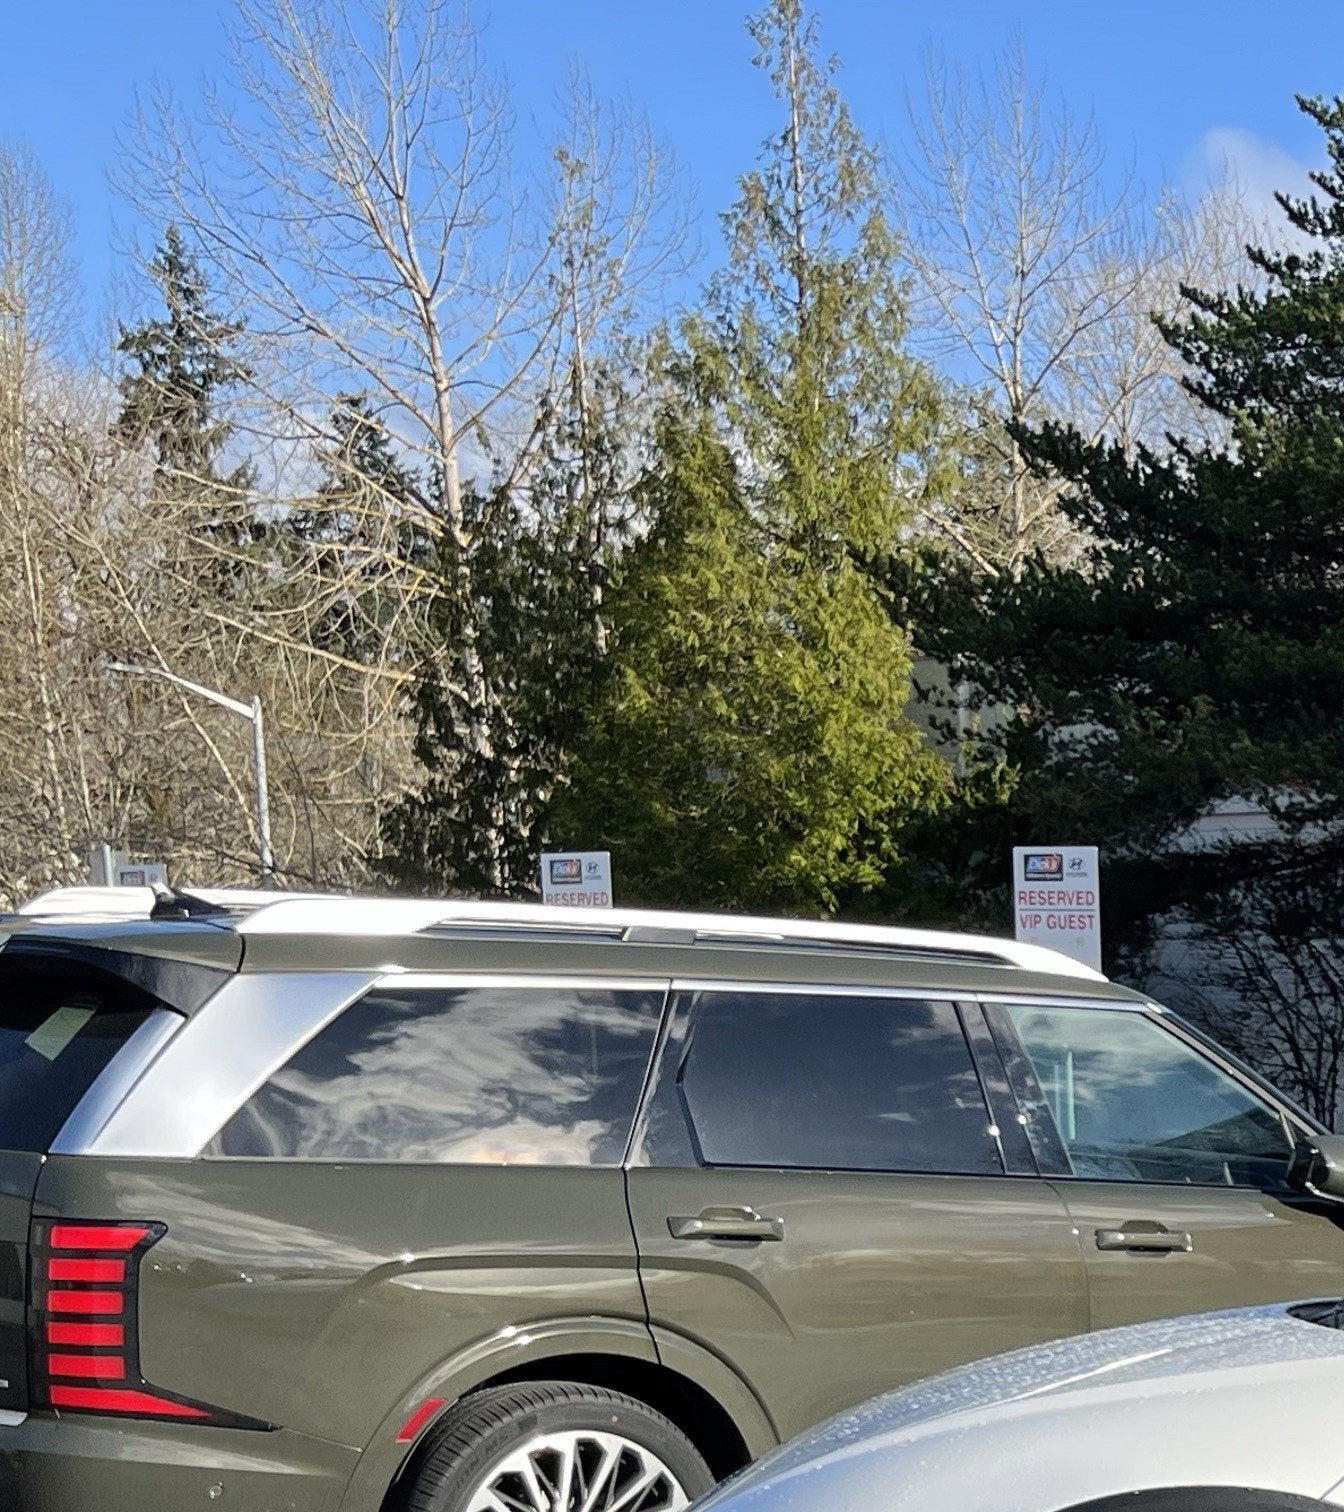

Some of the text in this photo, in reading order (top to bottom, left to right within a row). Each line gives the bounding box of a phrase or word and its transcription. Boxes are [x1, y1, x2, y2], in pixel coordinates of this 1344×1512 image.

[545, 892, 609, 907] RESERVED
[1018, 891, 1096, 906] RESERVED
[1020, 914, 1095, 930] VIP GUEST
